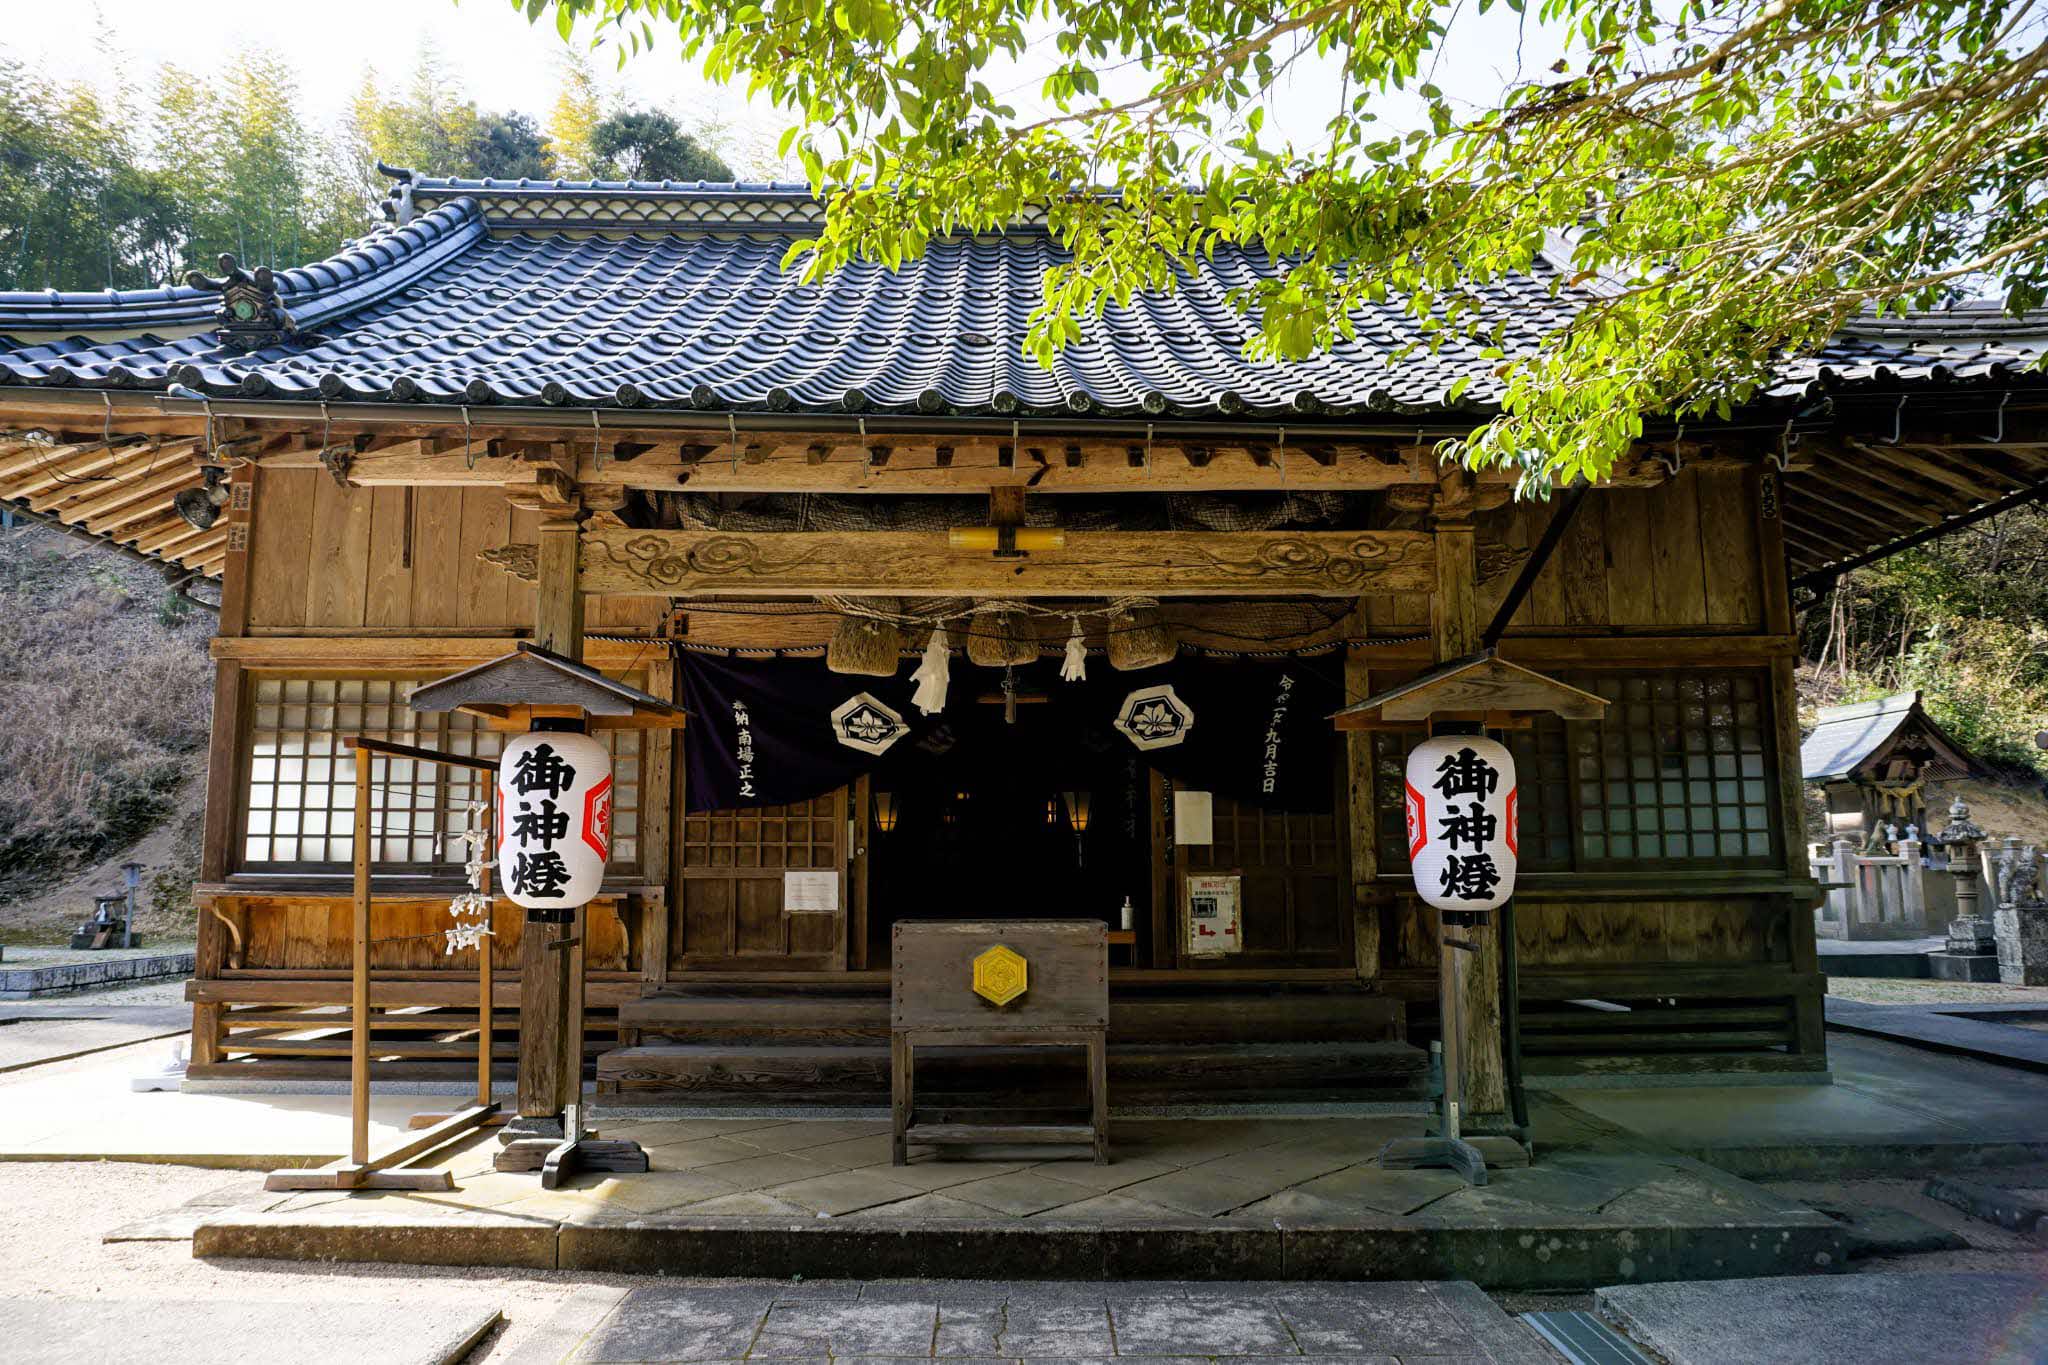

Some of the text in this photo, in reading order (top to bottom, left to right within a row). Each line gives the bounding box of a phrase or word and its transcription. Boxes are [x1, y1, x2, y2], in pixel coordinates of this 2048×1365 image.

[510, 743, 576, 898] 御神燈
[1432, 747, 1501, 900] 御神燈
